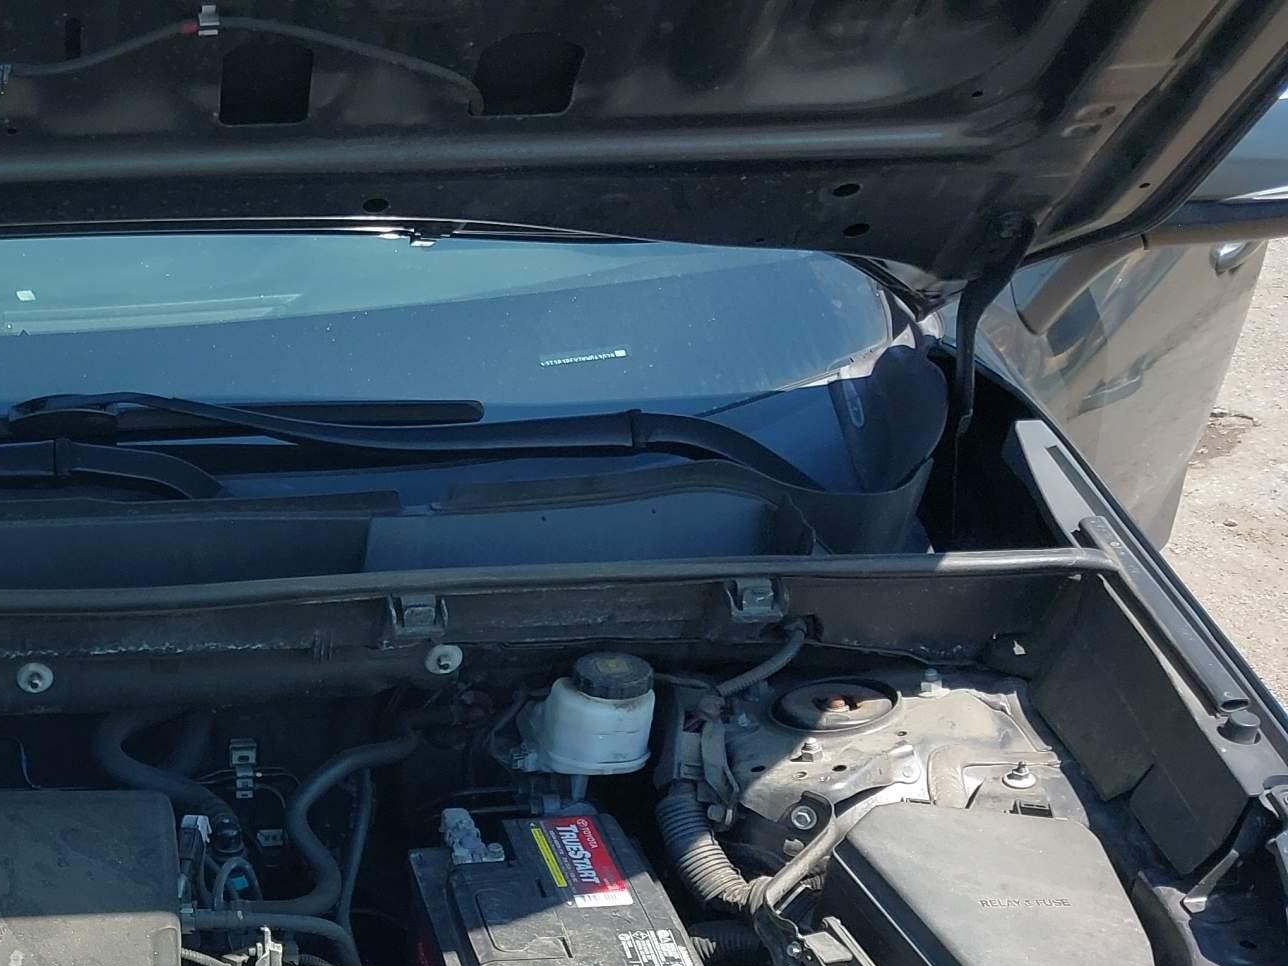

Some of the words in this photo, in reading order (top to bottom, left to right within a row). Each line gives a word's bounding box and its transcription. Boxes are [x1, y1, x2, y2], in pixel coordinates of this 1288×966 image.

[582, 827, 599, 849] TOYOTA
[979, 899, 1021, 908] RELAY
[1035, 898, 1072, 907] FUSE
